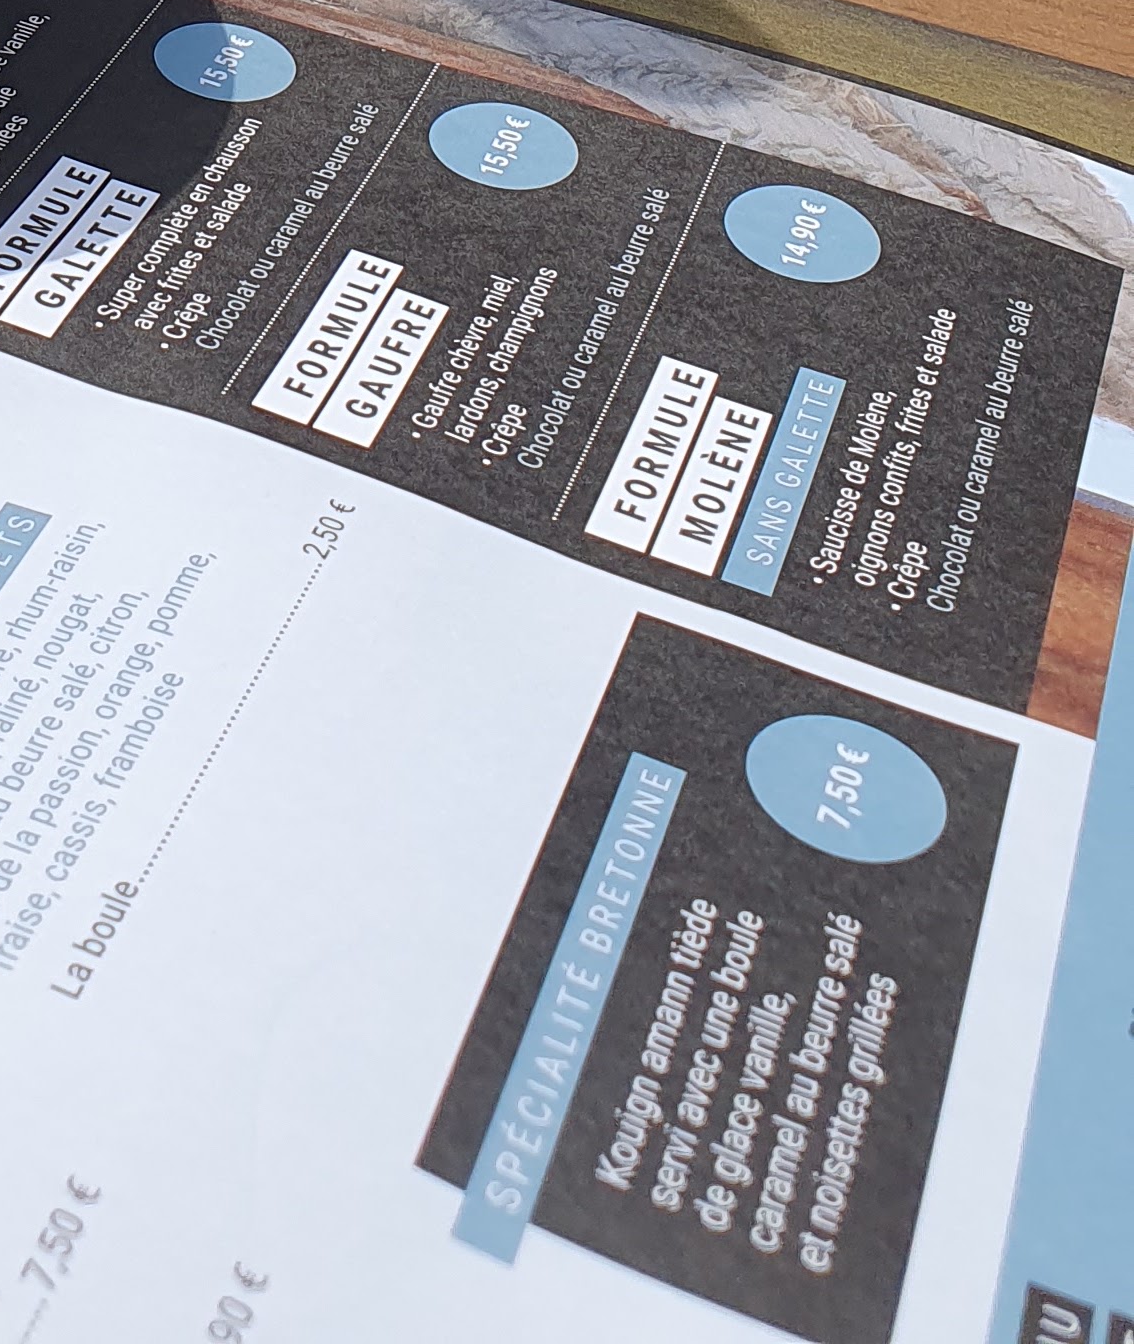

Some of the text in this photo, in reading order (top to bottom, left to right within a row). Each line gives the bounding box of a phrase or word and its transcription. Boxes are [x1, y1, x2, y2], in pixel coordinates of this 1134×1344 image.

[33, 188, 147, 308] GALETTE
[96, 117, 262, 320] Super complète en chausson
[134, 182, 251, 330] avec frites et salade
[282, 259, 390, 398] FORMULE
[344, 298, 436, 418] GAUFRE
[411, 274, 520, 428] Gaufre chèvre, miel,
[443, 266, 558, 443] lardons, champignons
[613, 367, 705, 522] FORMULE
[678, 408, 760, 545] MOLÈNE
[746, 378, 834, 565] SANS GALETTE
[808, 390, 898, 574] Saucisse de Molène,
[925, 297, 1034, 612] Chocolat ou caramel au beurre salé
[4, 522, 106, 640] rhum-raisin,
[302, 498, 356, 560] 2,50 €
[50, 880, 139, 1000] La boule
[484, 768, 672, 1214] SPÉCIALITÉ BRETONNE
[594, 898, 717, 1190] Kouign amann tiède
